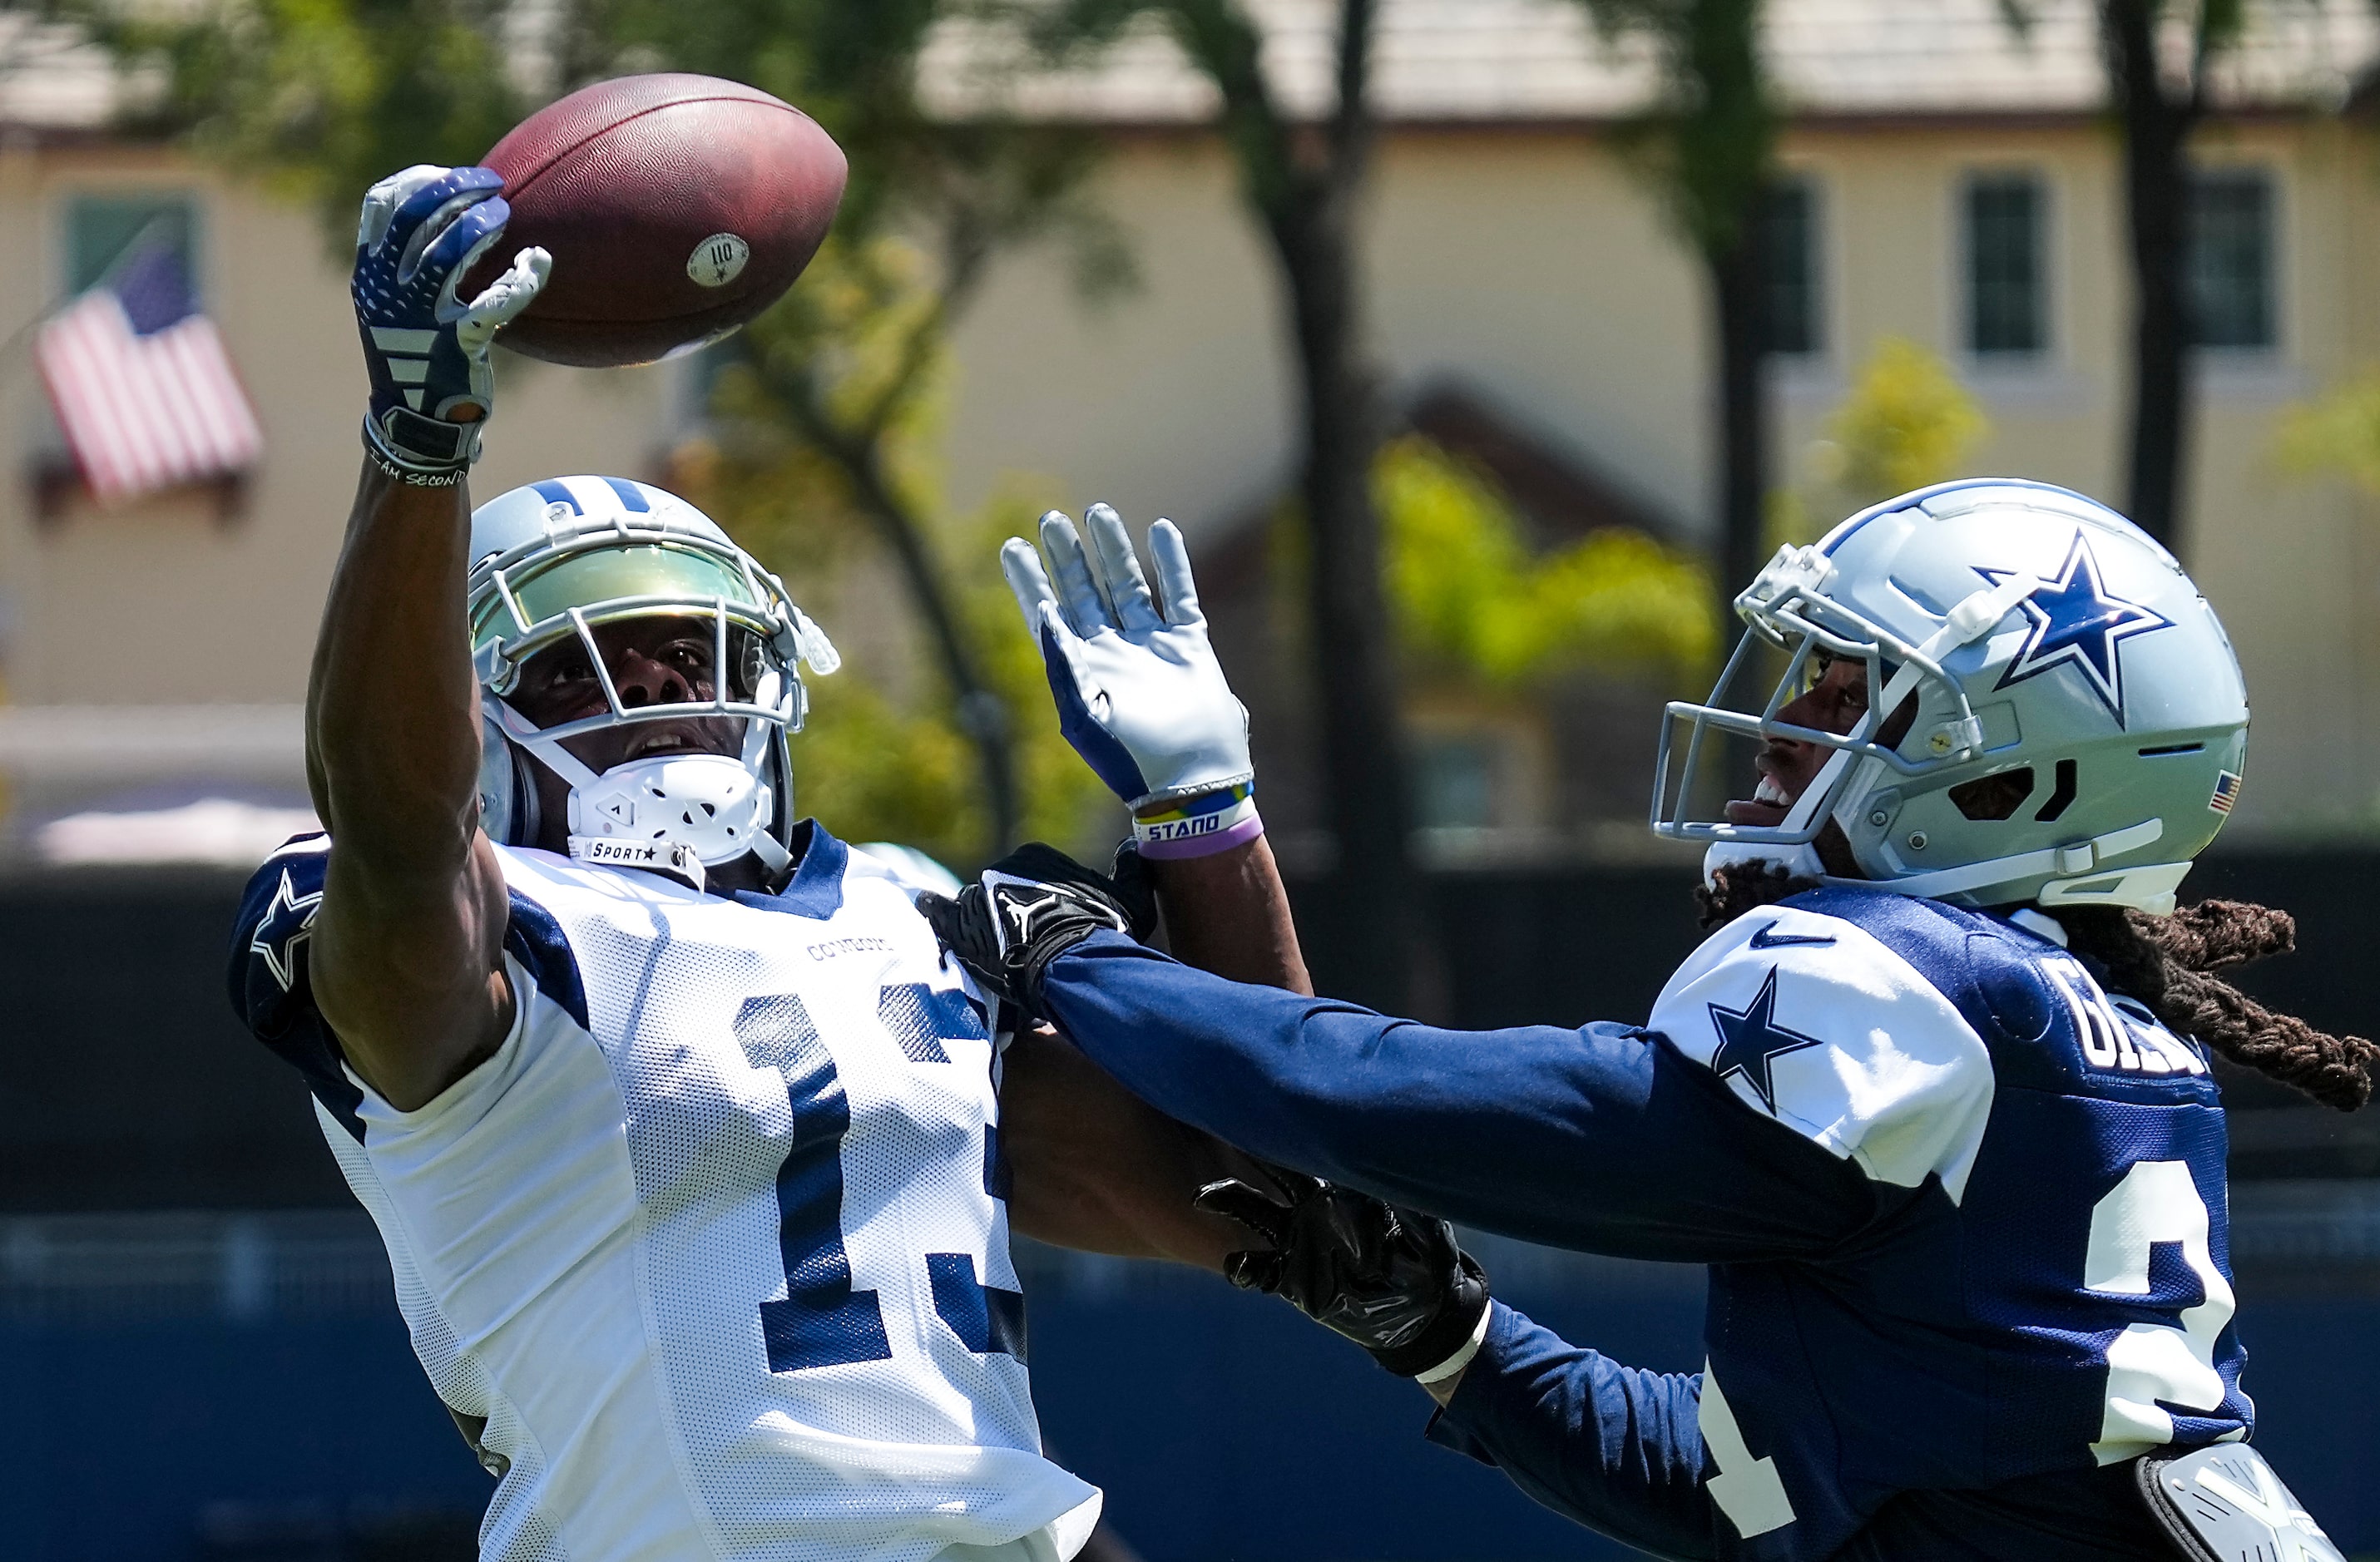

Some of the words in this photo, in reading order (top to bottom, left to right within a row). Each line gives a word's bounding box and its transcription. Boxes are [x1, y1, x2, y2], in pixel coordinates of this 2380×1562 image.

[369, 445, 381, 465] I
[380, 460, 401, 481] AM
[405, 468, 467, 487] SECOND
[1149, 814, 1220, 841] STAND
